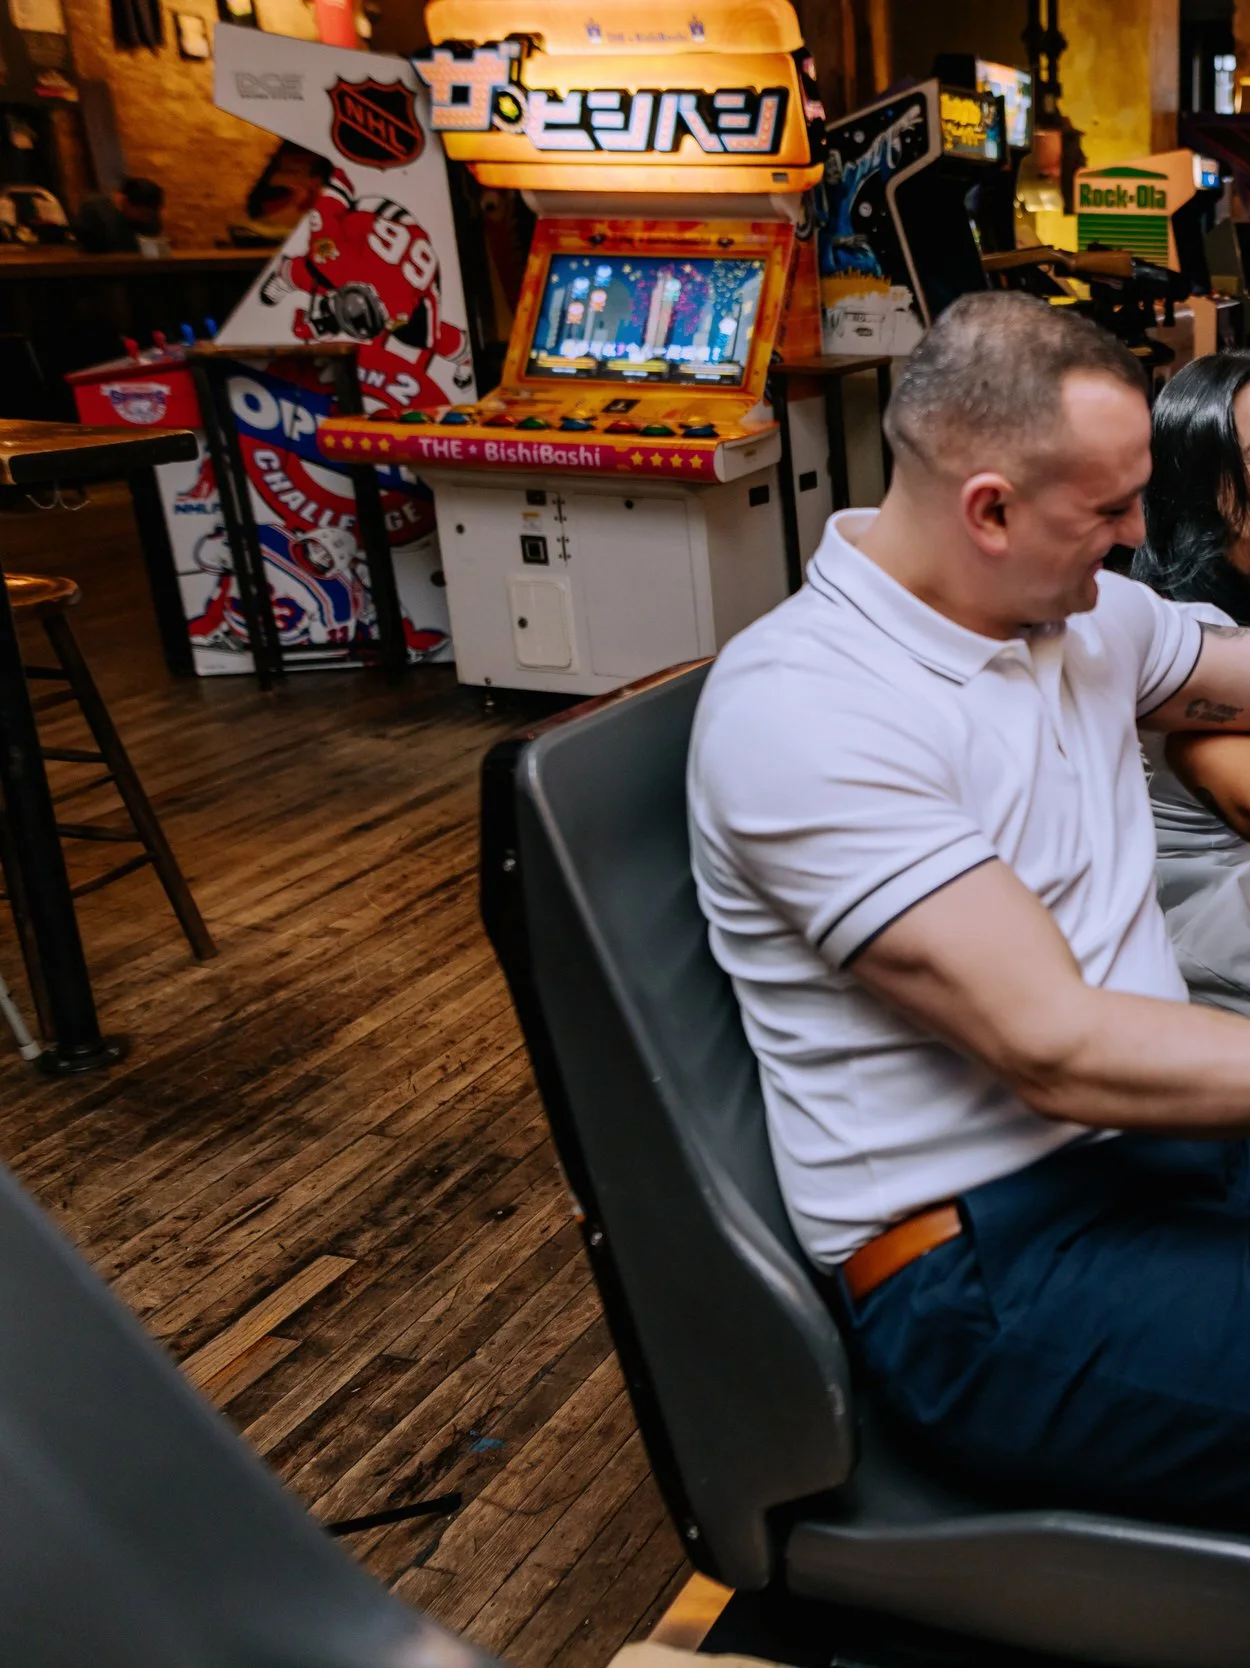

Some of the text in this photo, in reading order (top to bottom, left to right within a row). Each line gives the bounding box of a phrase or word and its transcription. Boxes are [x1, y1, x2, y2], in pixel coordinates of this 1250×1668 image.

[344, 96, 407, 152] NHL
[367, 219, 437, 291] 99
[385, 372, 421, 407] 2
[418, 437, 601, 467] THE BishiBashi
[253, 447, 423, 532] CHALLEGE
